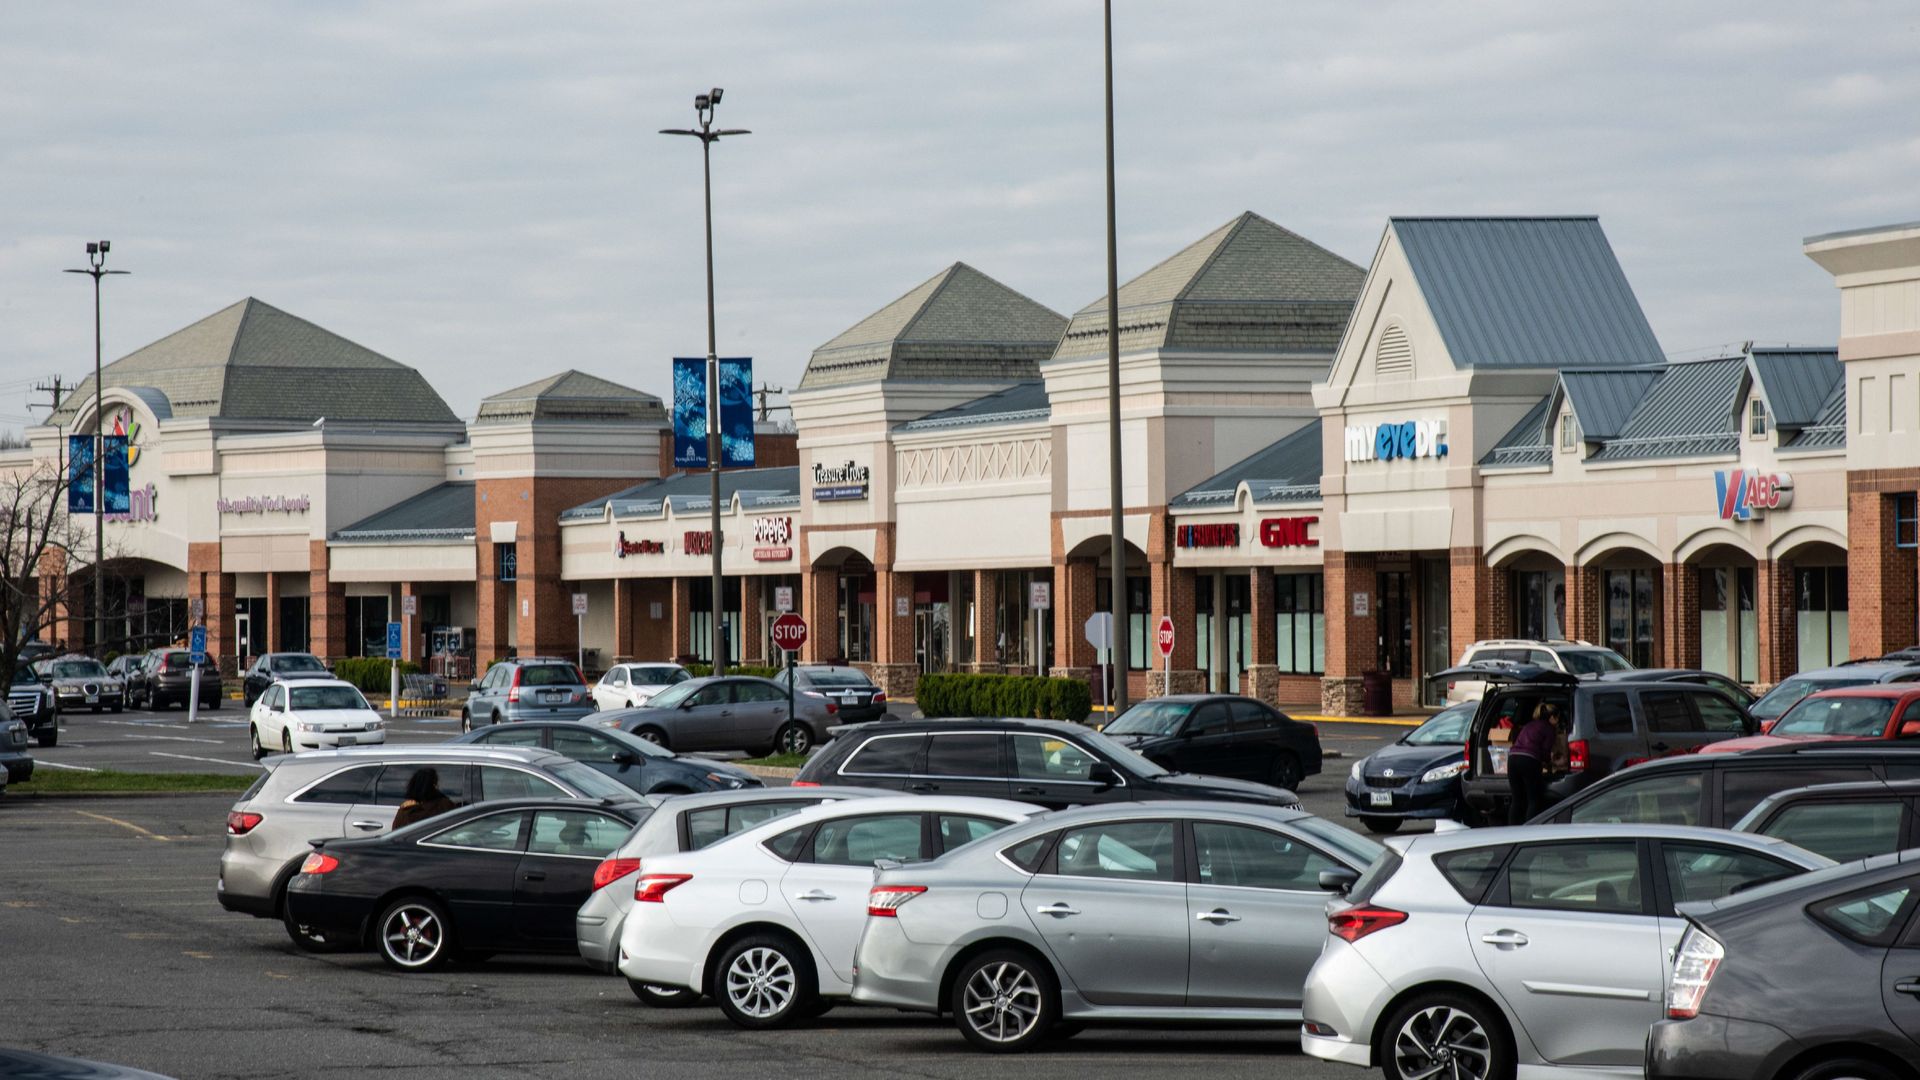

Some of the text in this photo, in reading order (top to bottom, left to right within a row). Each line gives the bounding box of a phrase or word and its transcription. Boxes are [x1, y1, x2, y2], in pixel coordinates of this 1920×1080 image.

[812, 460, 868, 483] Treasure Trove
[1743, 474, 1780, 508] ABC
[1260, 517, 1319, 547] GNC
[775, 625, 805, 639] STOP
[1160, 630, 1172, 644] STOP
